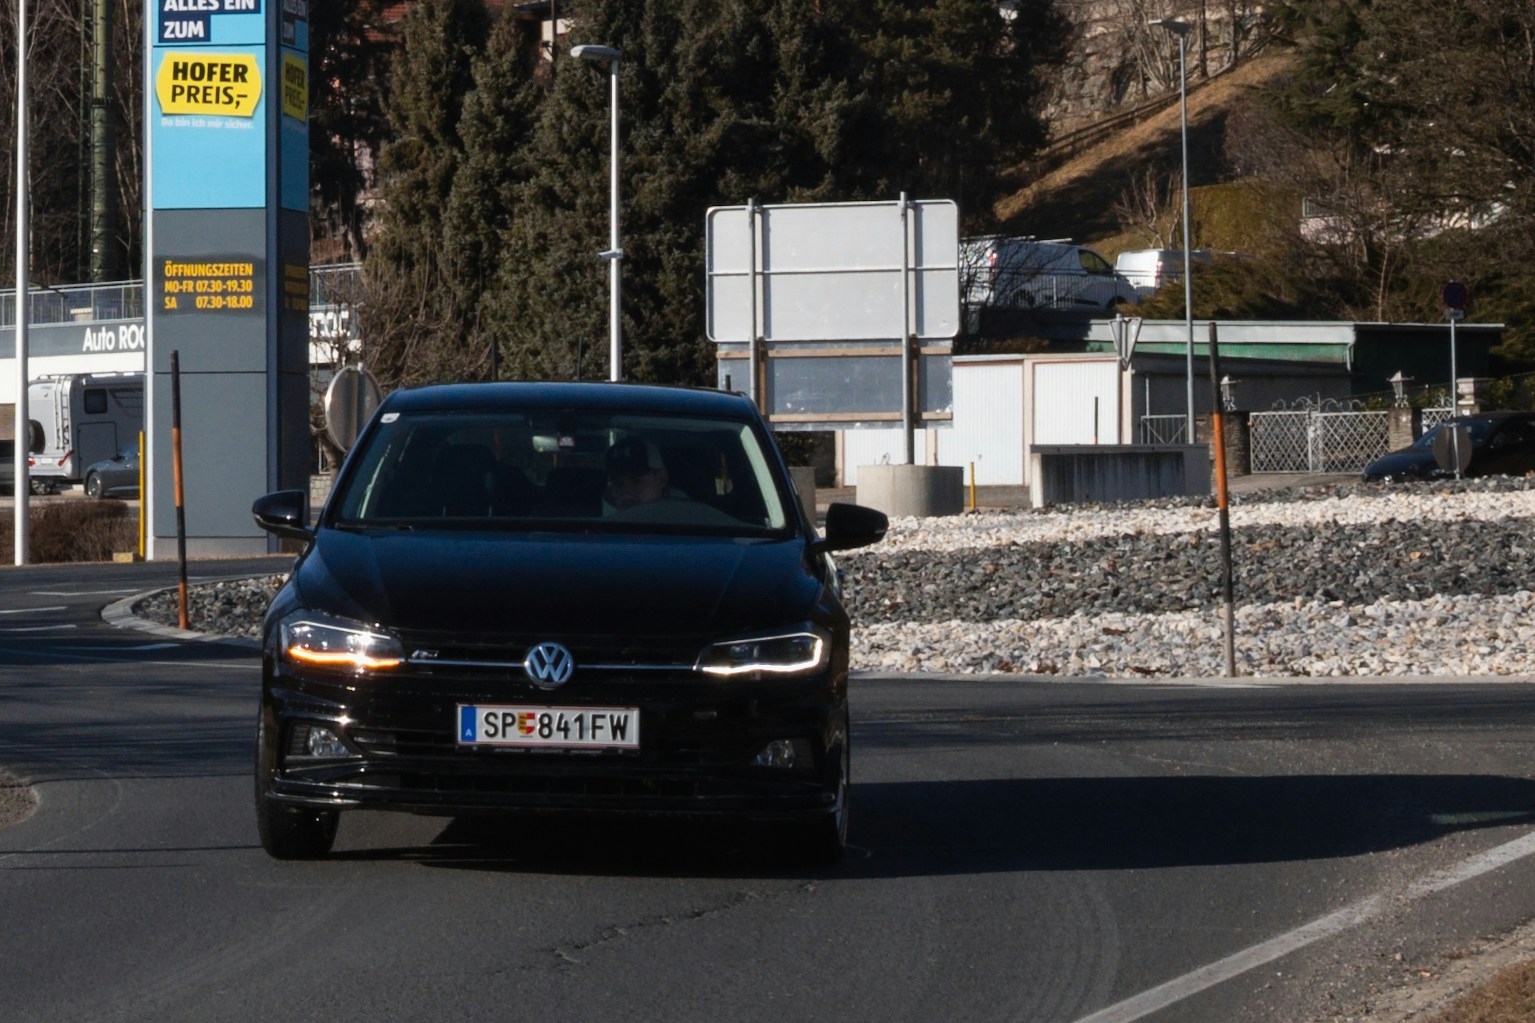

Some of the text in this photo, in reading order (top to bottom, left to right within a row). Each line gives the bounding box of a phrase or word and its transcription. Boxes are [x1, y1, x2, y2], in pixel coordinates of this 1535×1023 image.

[164, 21, 205, 39] ZUM
[173, 61, 249, 83] HOFER
[175, 117, 190, 127] bin
[191, 118, 206, 128] ich
[164, 260, 253, 277] ÖFFNUNGSZEITEN
[164, 279, 253, 293] MO-FR 07.30-19.30
[164, 295, 253, 309] SA 07.30-18.00
[82, 326, 116, 352] Auto
[465, 728, 473, 737] A
[483, 711, 516, 739] SP
